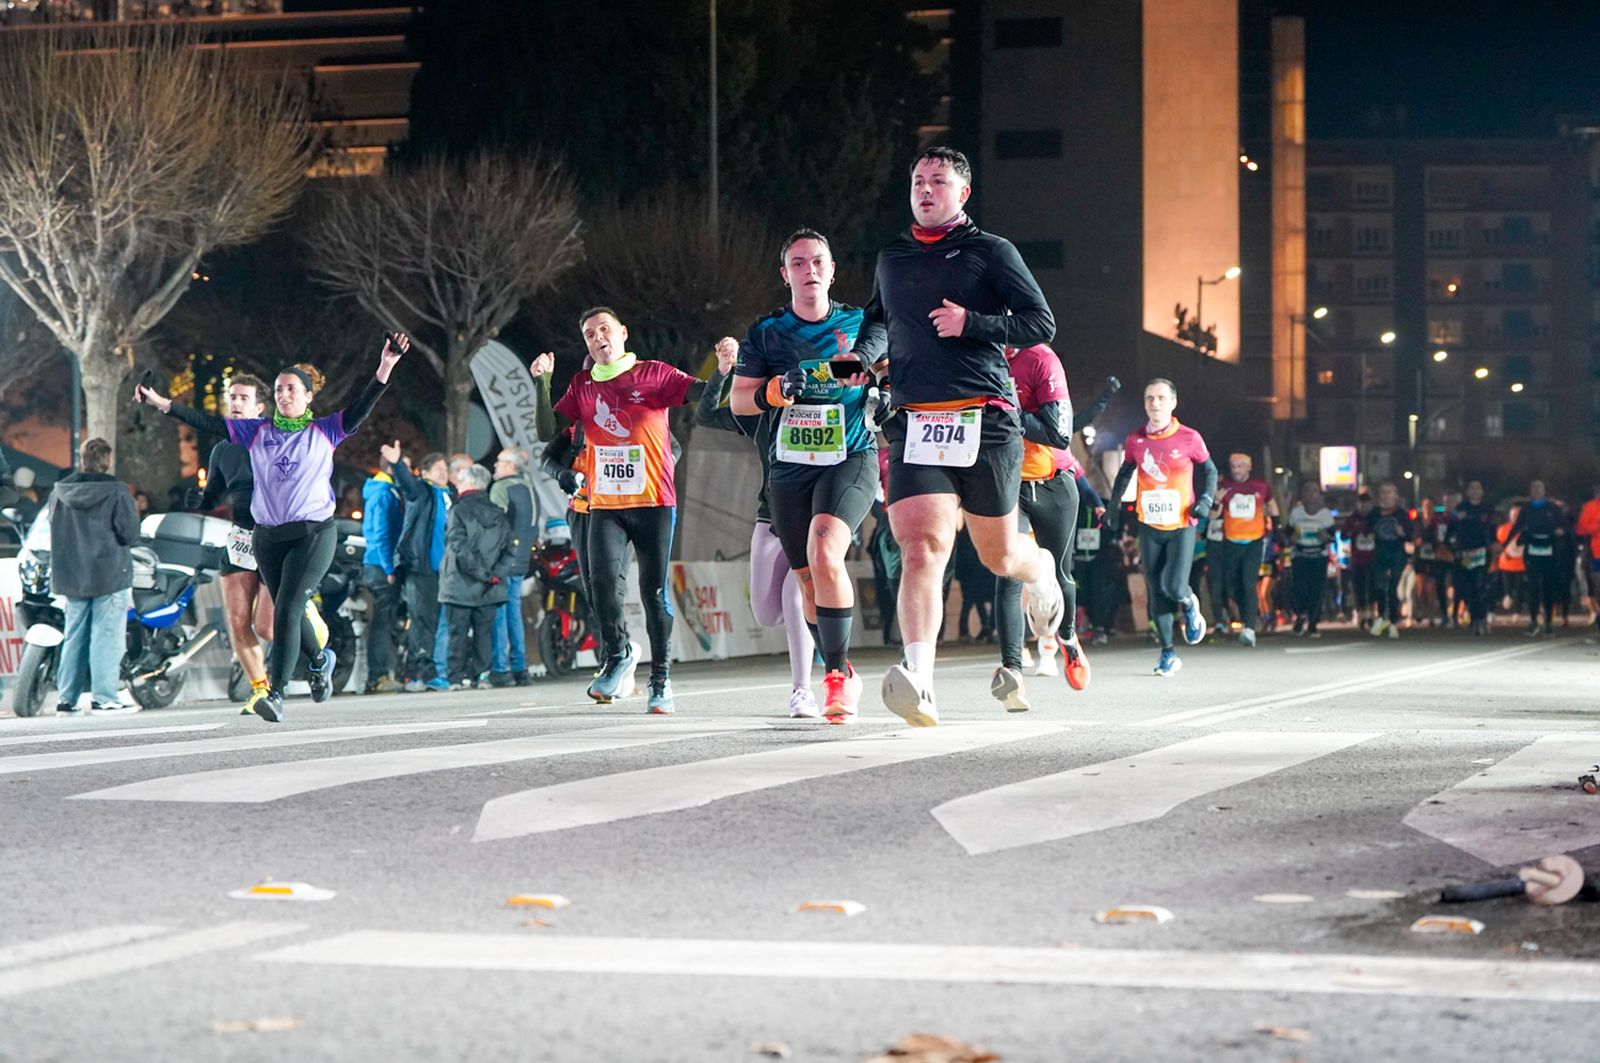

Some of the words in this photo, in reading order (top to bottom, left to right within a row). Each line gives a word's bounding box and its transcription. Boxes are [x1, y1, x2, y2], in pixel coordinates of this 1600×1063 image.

[604, 418, 618, 431] 43
[789, 427, 834, 446] 8692
[921, 424, 966, 444] 2674
[603, 463, 635, 478] 4766
[1148, 503, 1173, 513] 6504
